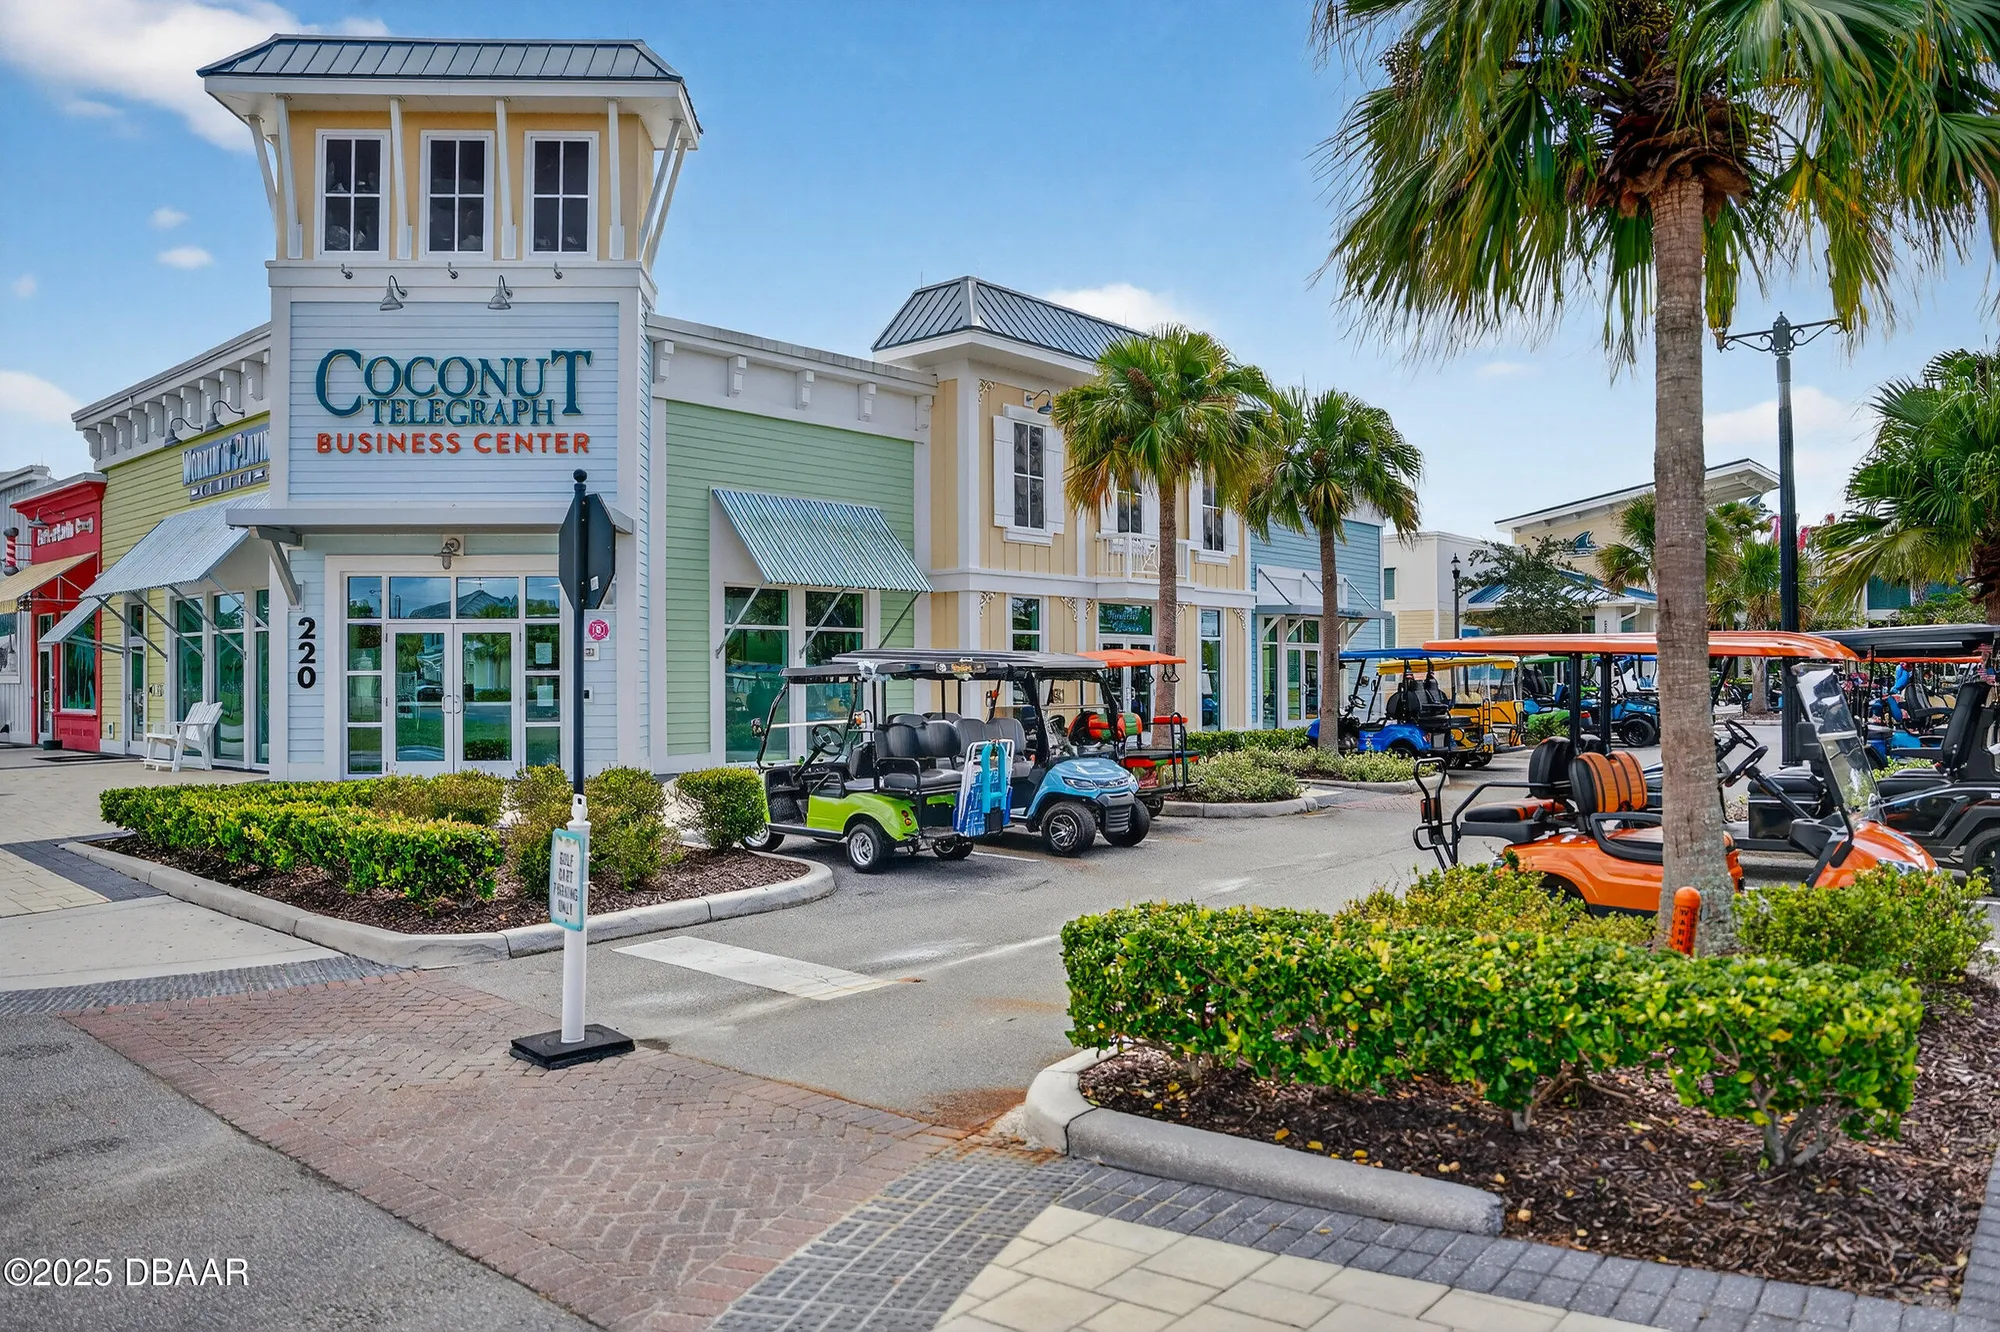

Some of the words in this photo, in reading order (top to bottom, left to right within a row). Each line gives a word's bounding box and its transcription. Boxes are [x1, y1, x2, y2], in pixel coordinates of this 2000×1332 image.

[315, 348, 592, 417] COCONUT
[367, 398, 556, 426] TELEGRAPH
[317, 432, 461, 454] BUSINESS
[473, 432, 590, 454] CENTER
[297, 616, 316, 689] 220
